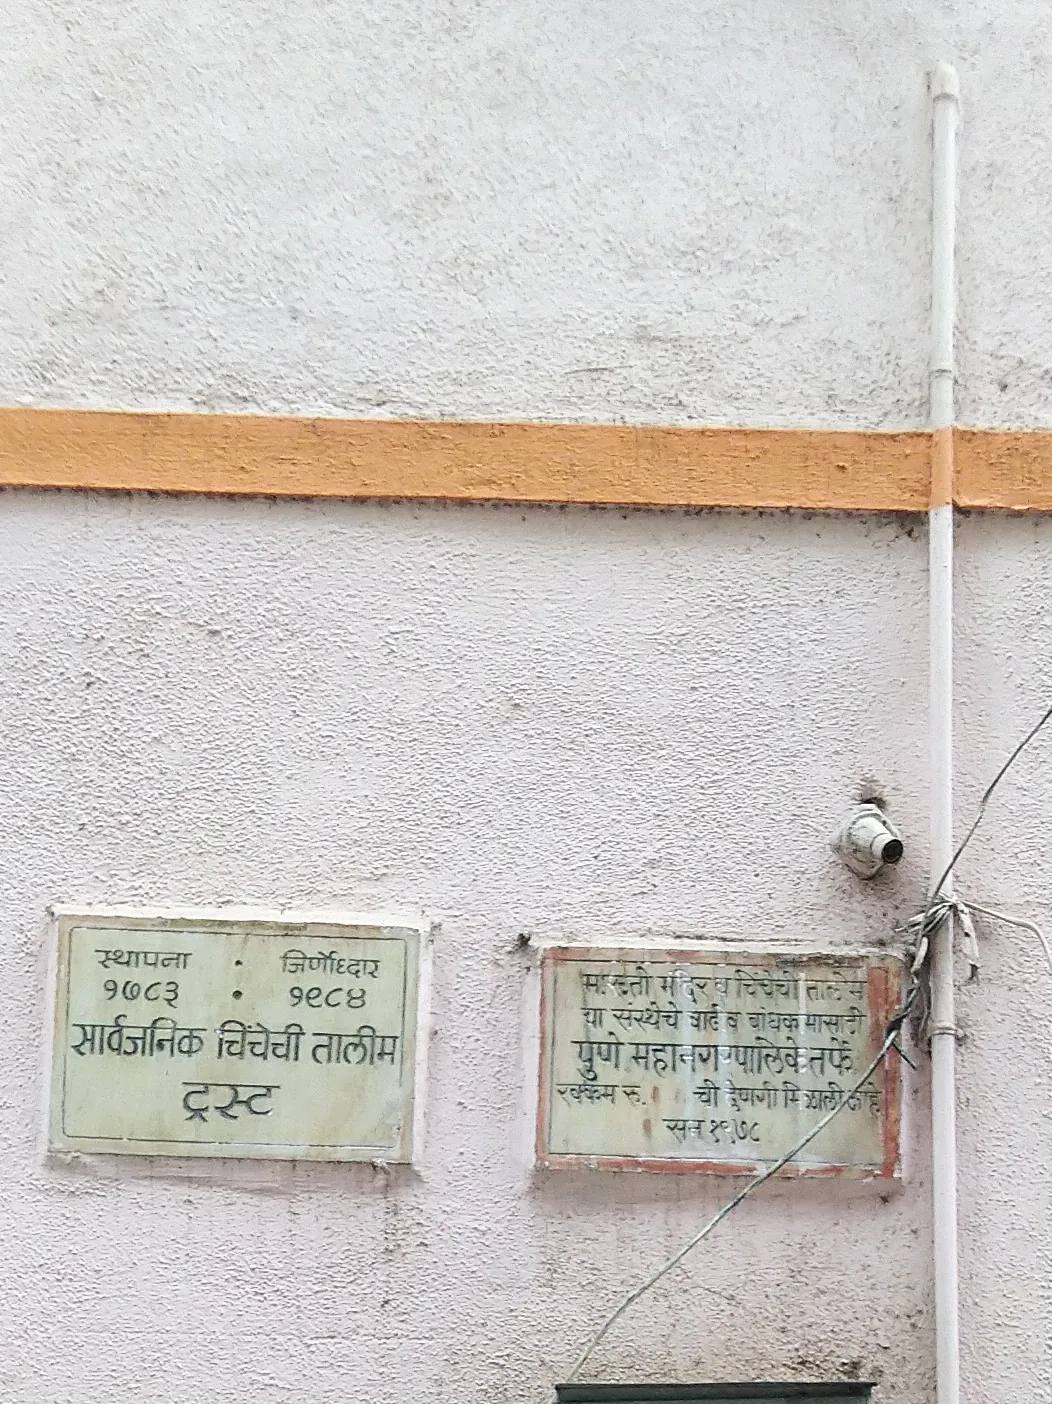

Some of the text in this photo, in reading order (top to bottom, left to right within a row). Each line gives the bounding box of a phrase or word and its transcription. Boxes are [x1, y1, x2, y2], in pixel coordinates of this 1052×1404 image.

[94, 949, 193, 970] स्थापना
[103, 980, 368, 1010] १७८३ १९८४
[713, 974, 731, 998] व
[70, 1014, 399, 1066] सार्वजनिक चिंचेची तालीम
[570, 1031, 624, 1081] पुणे
[181, 1081, 281, 1123] ट्रस्ट
[692, 1079, 721, 1107] ची
[662, 1118, 706, 1143] सन
